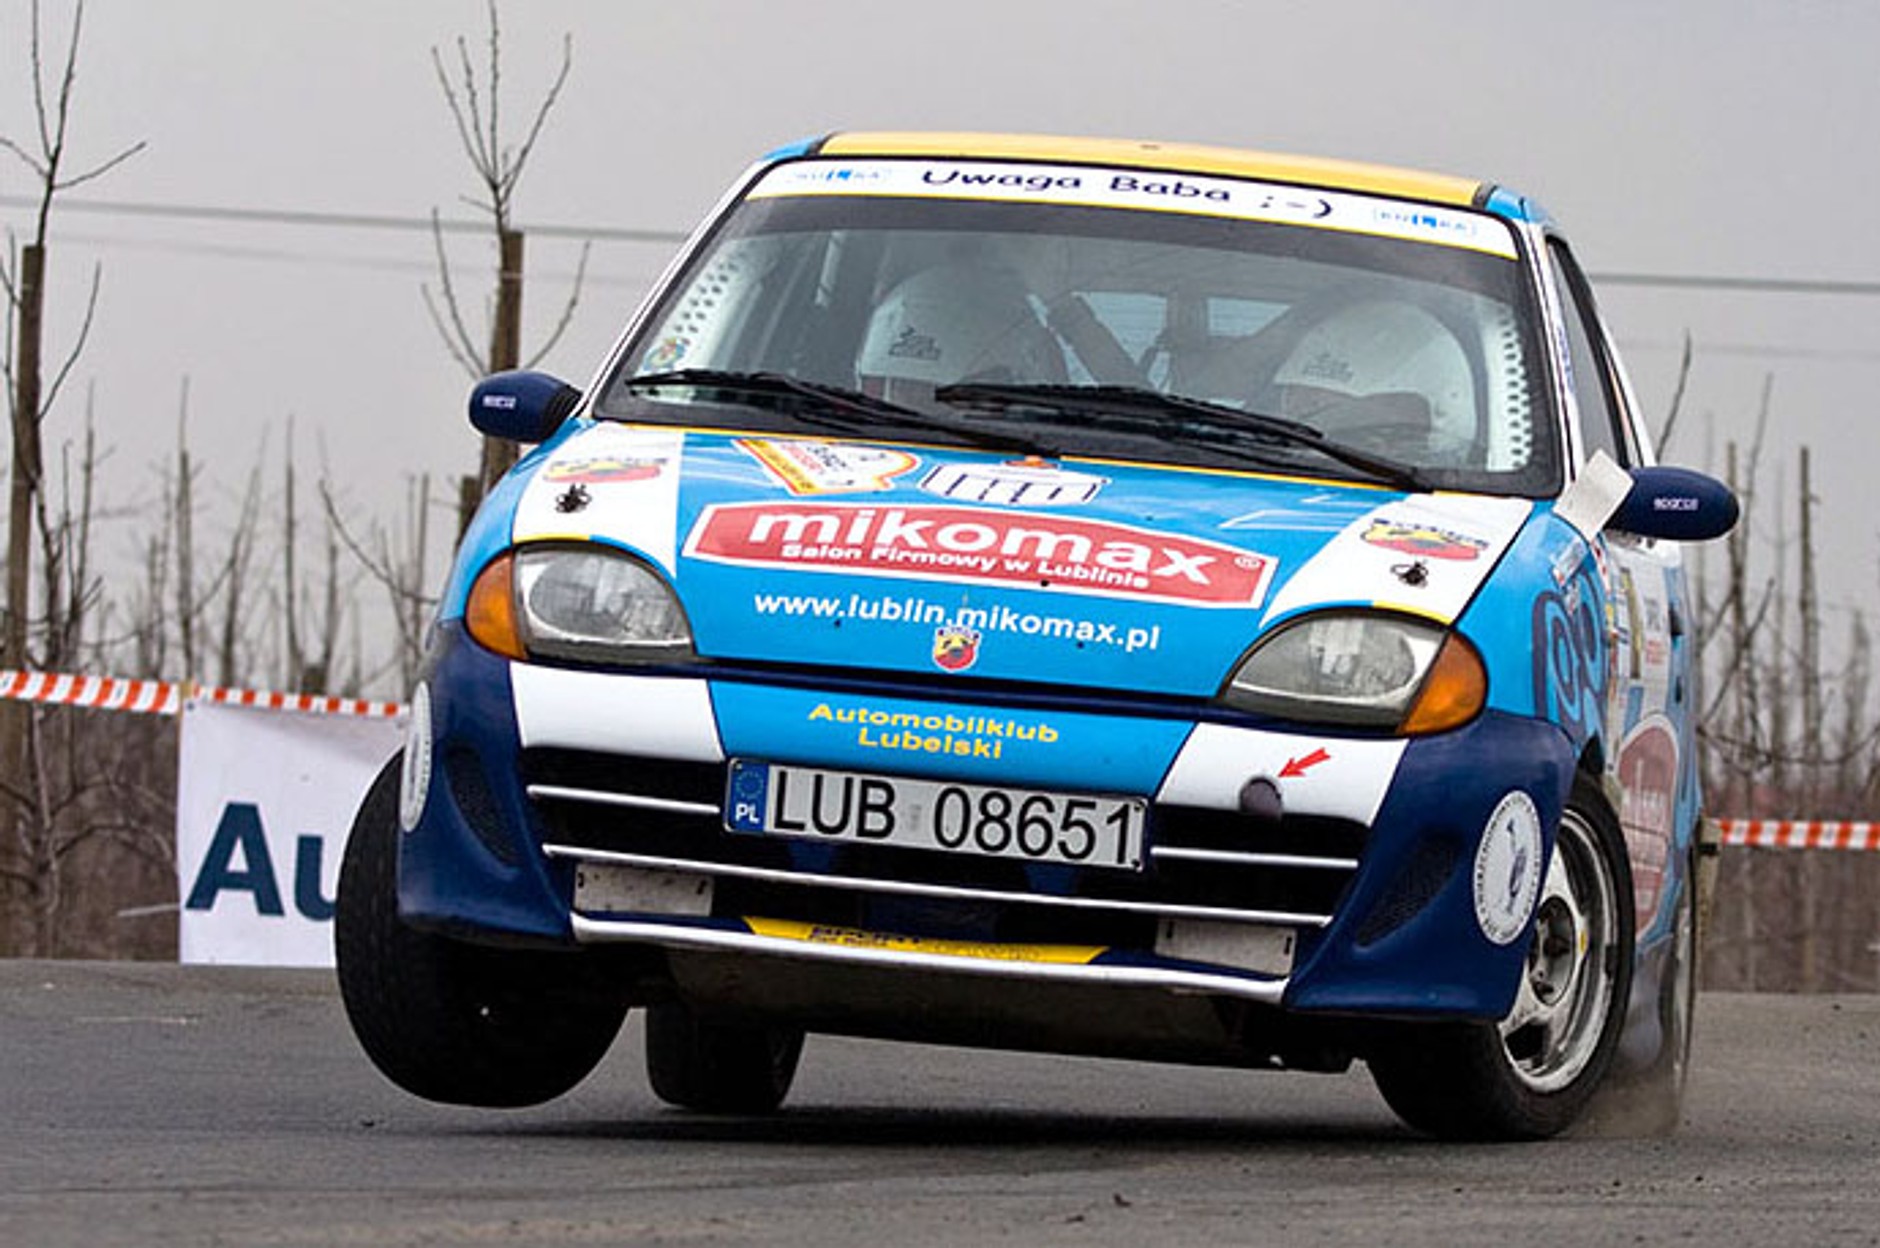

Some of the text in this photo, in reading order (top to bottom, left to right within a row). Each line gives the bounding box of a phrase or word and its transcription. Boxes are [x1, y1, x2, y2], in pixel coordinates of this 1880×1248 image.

[922, 168, 1081, 192] Uwaga
[1110, 174, 1231, 201] Baba
[749, 508, 1217, 585] mikomax
[781, 544, 1150, 588] Salon Firmowy w Lublinie
[753, 594, 1161, 650] www.lublin.mikomax.pl
[808, 703, 1059, 744] Automobilklub
[858, 728, 1003, 760] Lubelski
[735, 803, 762, 824] PL
[773, 770, 1130, 866] LUB 08651
